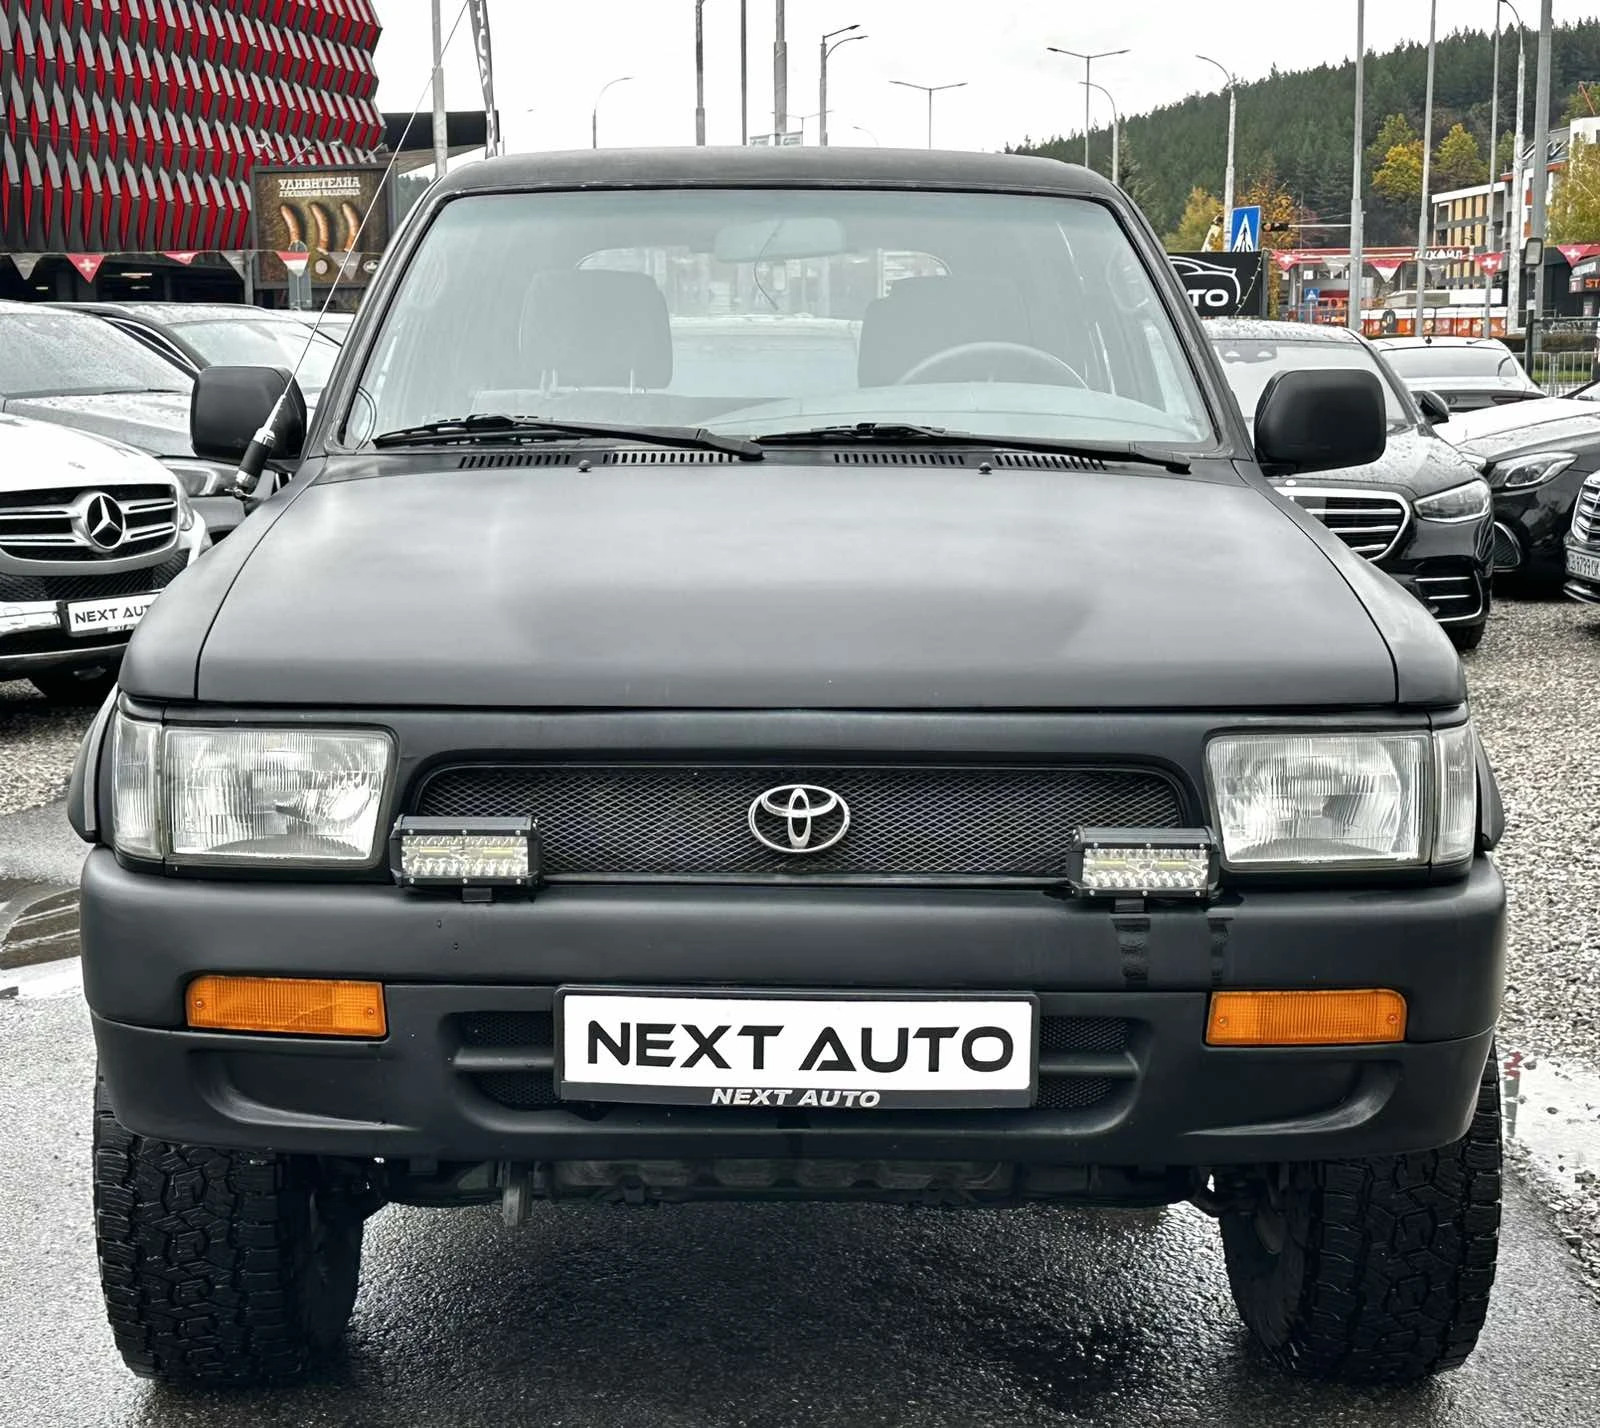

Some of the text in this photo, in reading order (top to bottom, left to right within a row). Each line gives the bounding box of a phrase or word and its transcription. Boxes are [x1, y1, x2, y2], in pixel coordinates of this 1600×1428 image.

[75, 608, 118, 624] NEXT
[587, 1020, 1014, 1073] NEXT AUTO
[711, 1088, 880, 1108] NEXT AUTO
